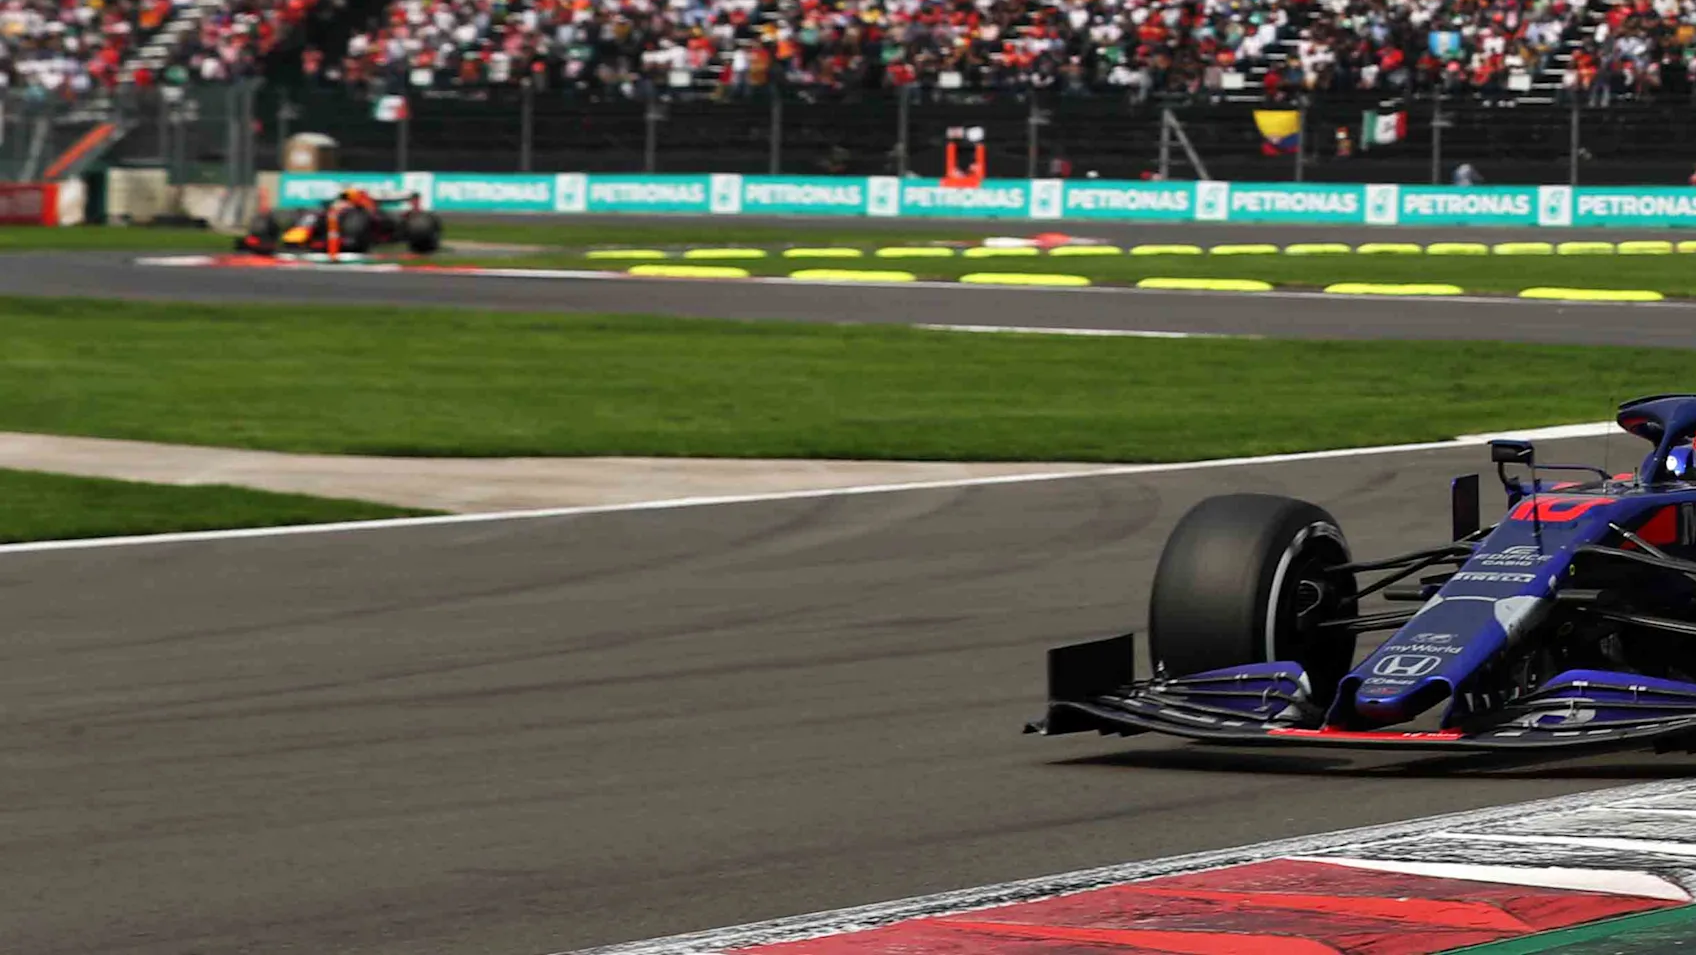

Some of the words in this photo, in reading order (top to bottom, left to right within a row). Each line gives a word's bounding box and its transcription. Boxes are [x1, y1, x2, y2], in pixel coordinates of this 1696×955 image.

[437, 181, 550, 201] PETRONAS
[590, 182, 704, 202] PETRONAS
[746, 184, 861, 205] PETRONAS
[904, 186, 1024, 208] PETRONAS
[1068, 189, 1189, 210] PETRONAS
[1233, 191, 1358, 212] PETRONAS
[1404, 194, 1530, 214] PETRONAS
[1511, 498, 1616, 522] 10
[1473, 553, 1554, 562] EDIFICE
[1384, 643, 1464, 655] myWorld
